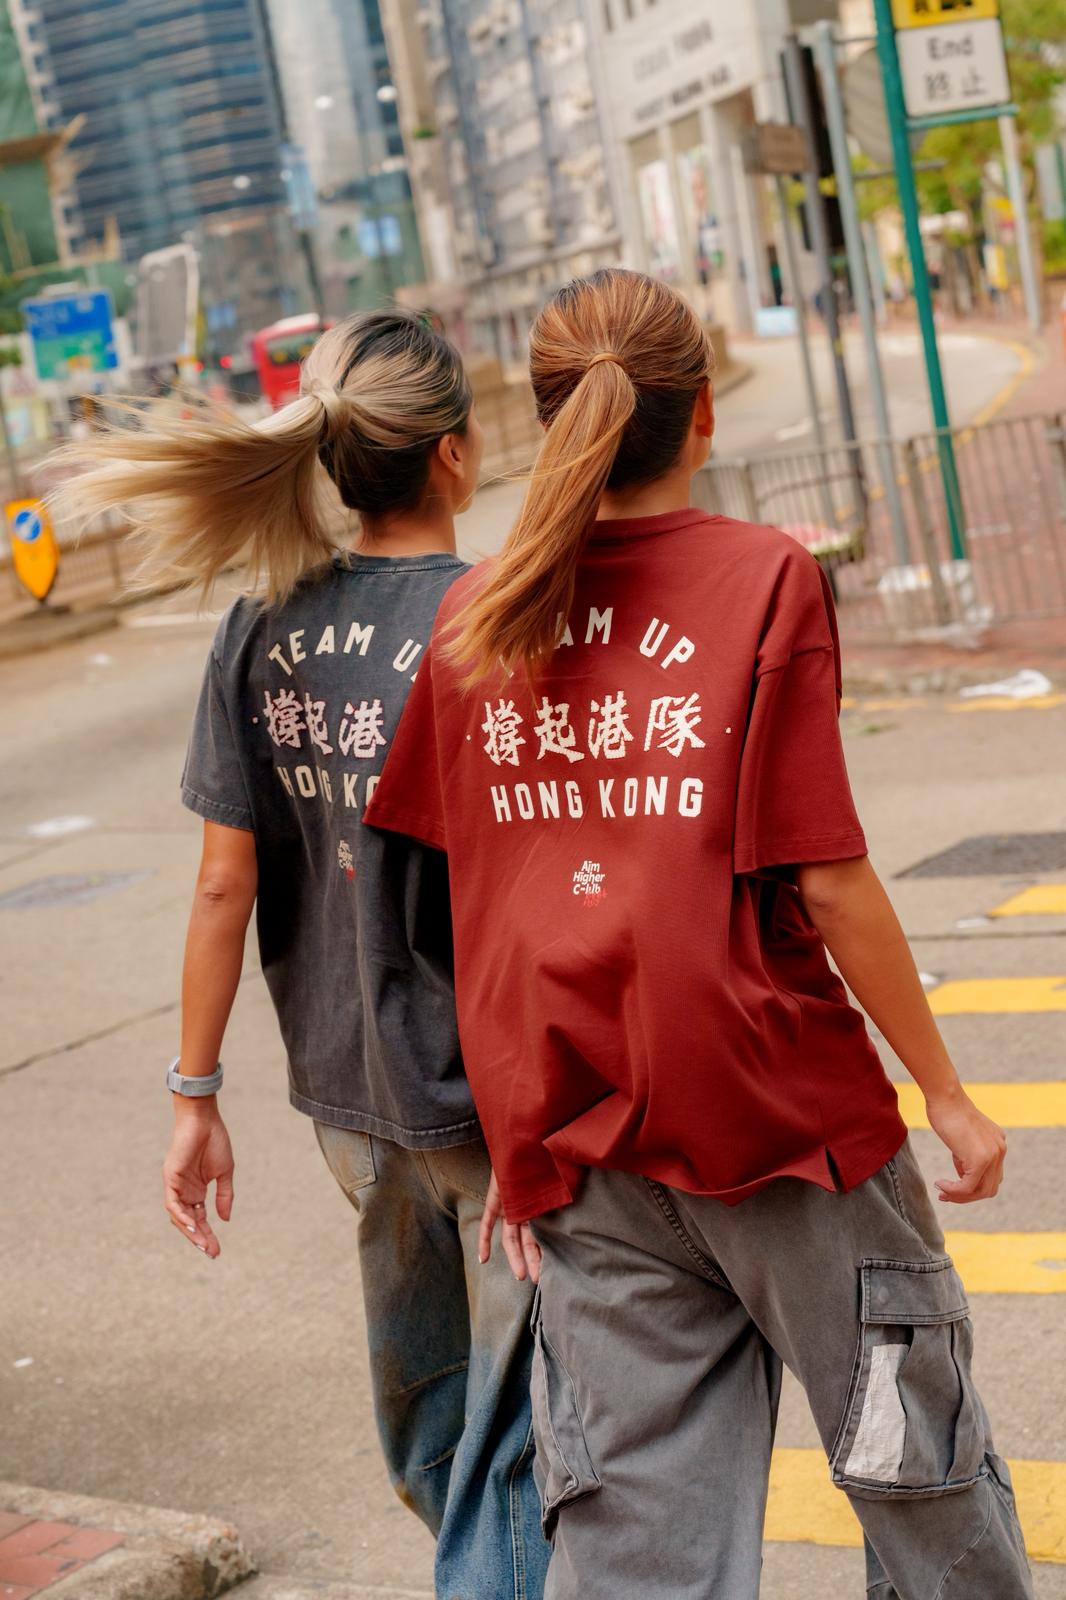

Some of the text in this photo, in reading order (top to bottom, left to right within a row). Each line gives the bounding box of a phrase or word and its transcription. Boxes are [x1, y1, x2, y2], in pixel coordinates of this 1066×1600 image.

[927, 35, 975, 61] End
[267, 621, 422, 684] TEAM U
[639, 617, 696, 670] UP
[481, 691, 706, 767] 撐起港隊
[490, 776, 704, 823] HONG KONG
[573, 871, 605, 885] Higher
[581, 860, 600, 873] Aim
